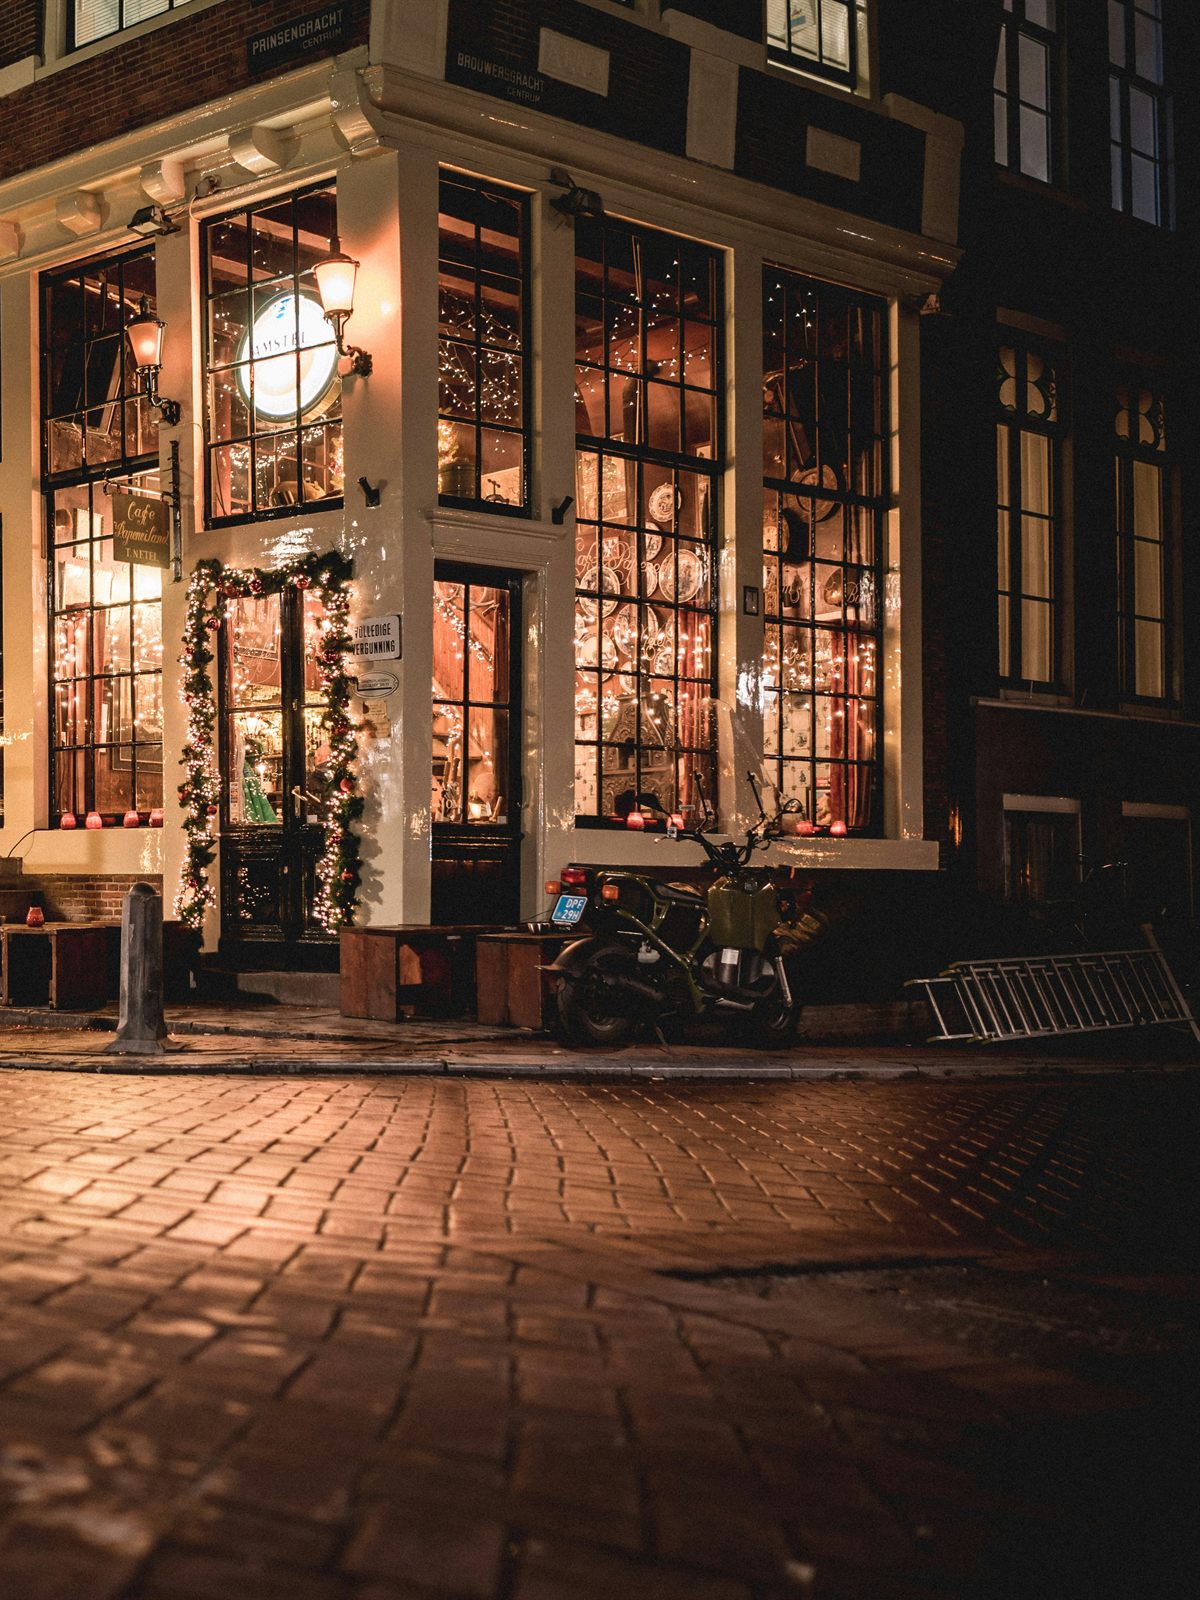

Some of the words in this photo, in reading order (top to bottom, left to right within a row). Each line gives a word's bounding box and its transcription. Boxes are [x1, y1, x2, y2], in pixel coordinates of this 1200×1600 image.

[252, 9, 343, 55] PRINSENGRACHT
[302, 27, 342, 50] CENTRUM
[457, 52, 545, 93] BROUWERSGRACHT
[506, 85, 541, 103] CENTRUM
[352, 640, 396, 655] VERGUNNING
[566, 899, 584, 909] DPF
[561, 910, 580, 919] 29H
